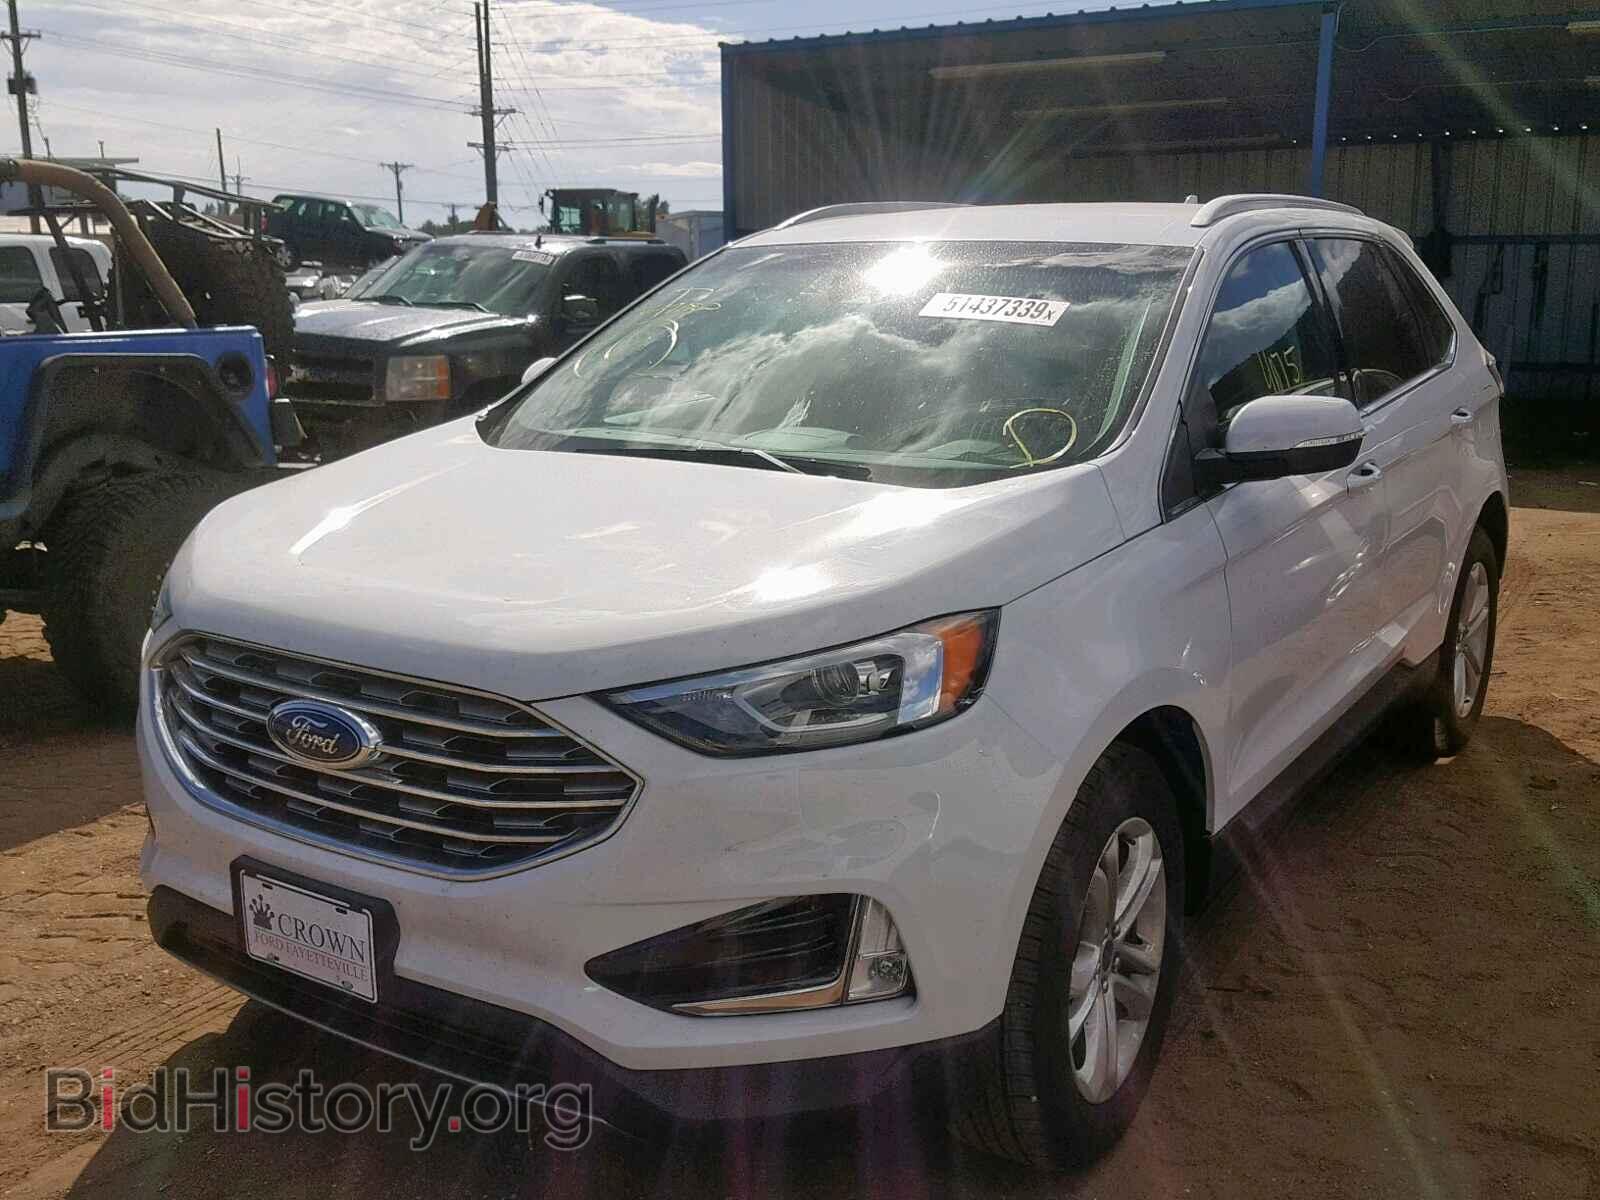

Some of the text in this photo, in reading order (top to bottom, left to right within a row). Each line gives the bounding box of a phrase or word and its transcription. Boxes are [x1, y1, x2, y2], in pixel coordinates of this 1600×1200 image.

[285, 715, 341, 754] Ford
[254, 932, 369, 982] FORD FAYETTEVILLE
[278, 913, 367, 963] CROWN
